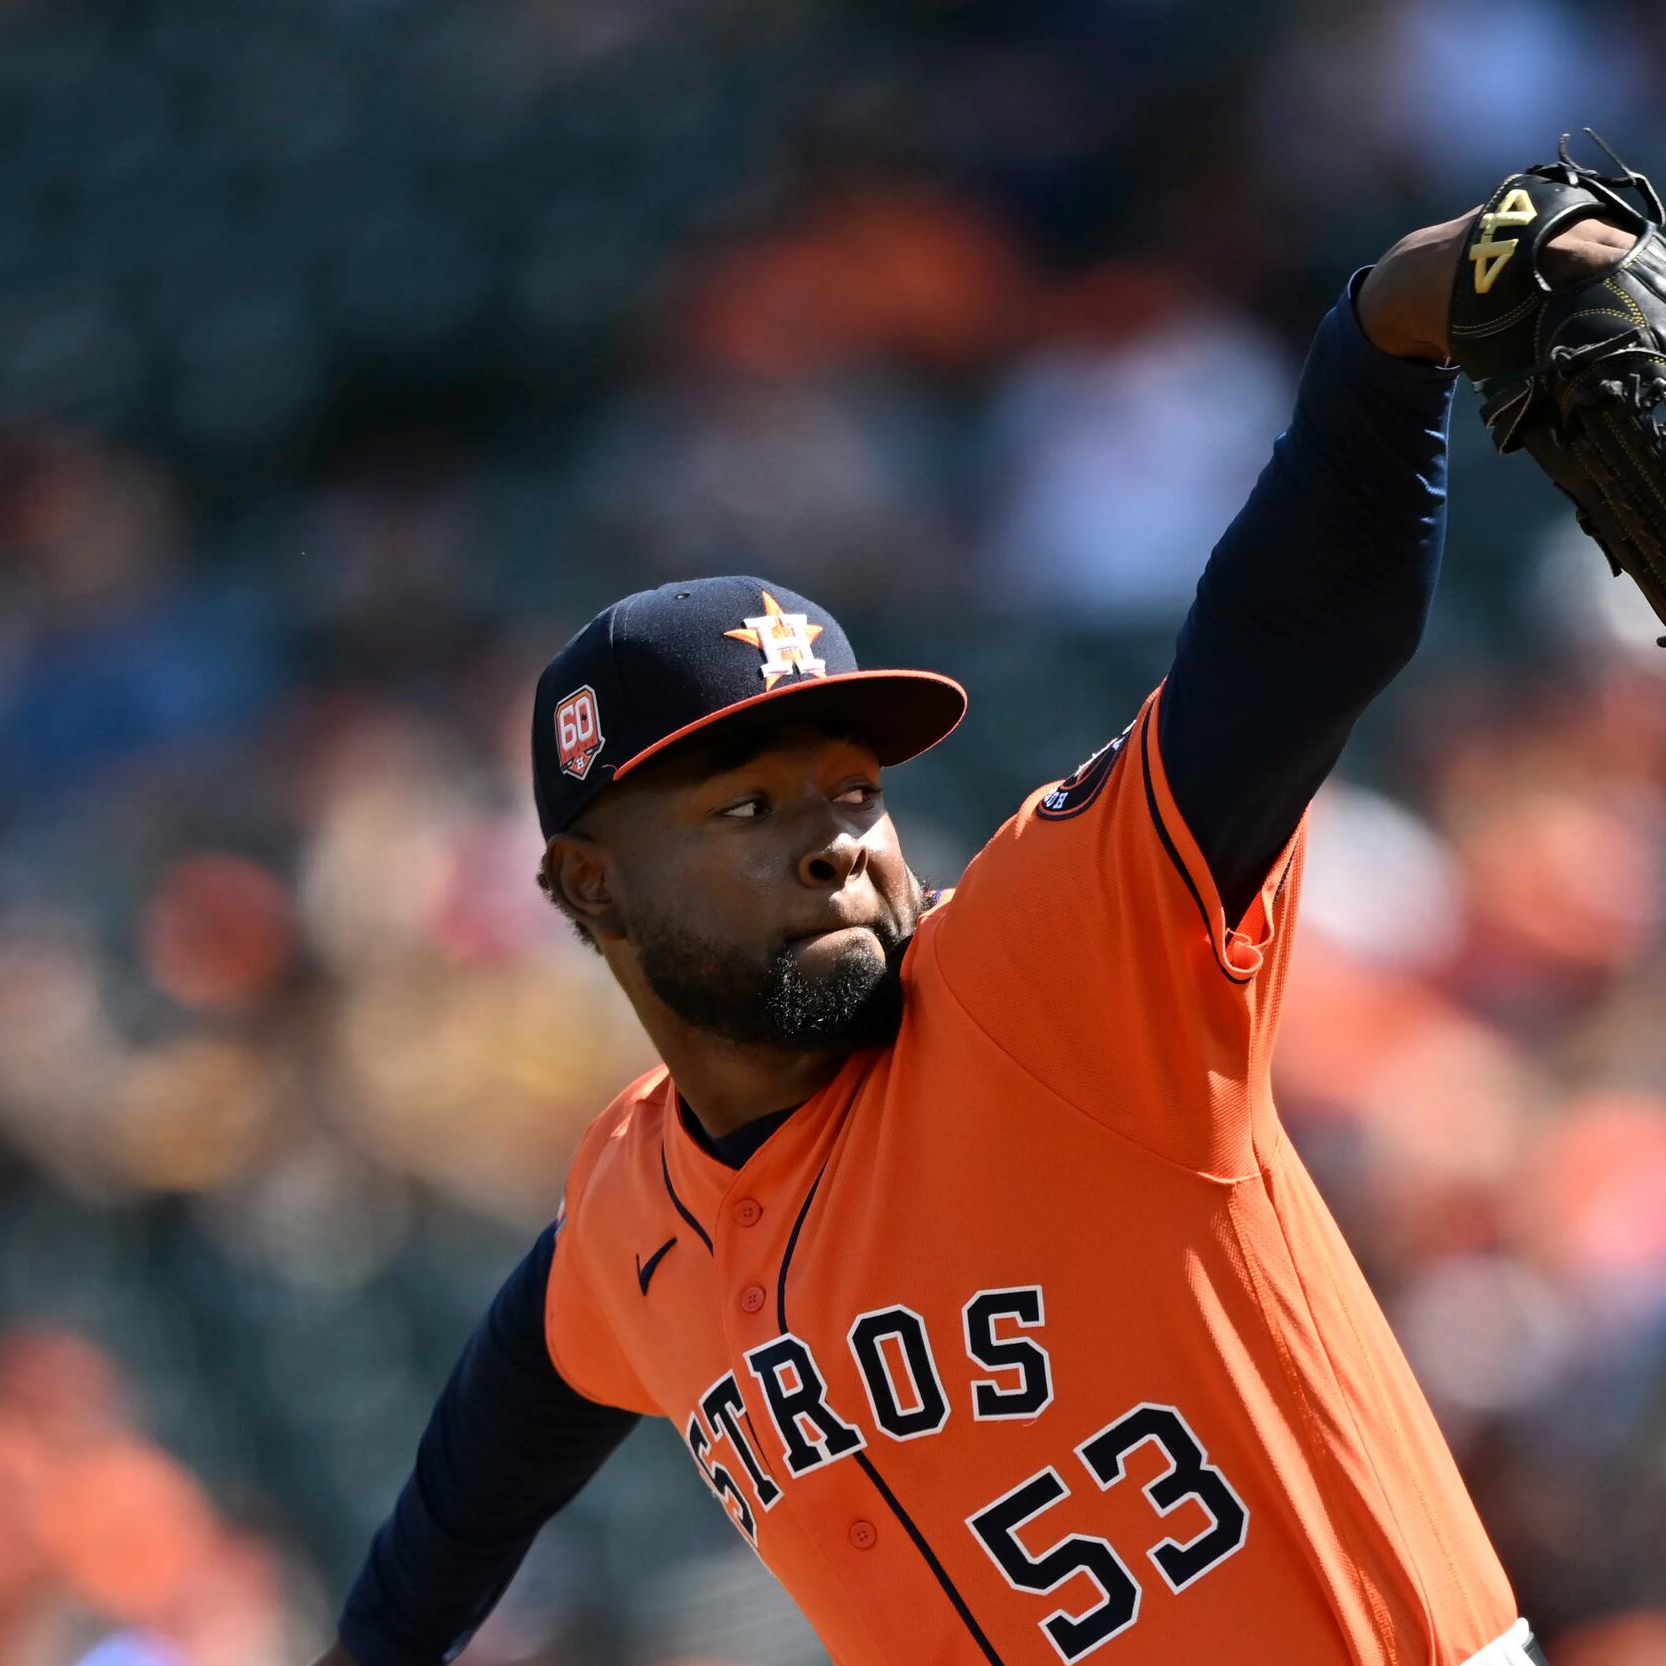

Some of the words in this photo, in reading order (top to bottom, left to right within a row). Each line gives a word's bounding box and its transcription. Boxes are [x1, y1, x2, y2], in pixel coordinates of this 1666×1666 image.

[1468, 189, 1537, 293] 44
[559, 695, 594, 752] 60
[686, 1285, 1054, 1548] STROS
[965, 1402, 1250, 1666] 53
